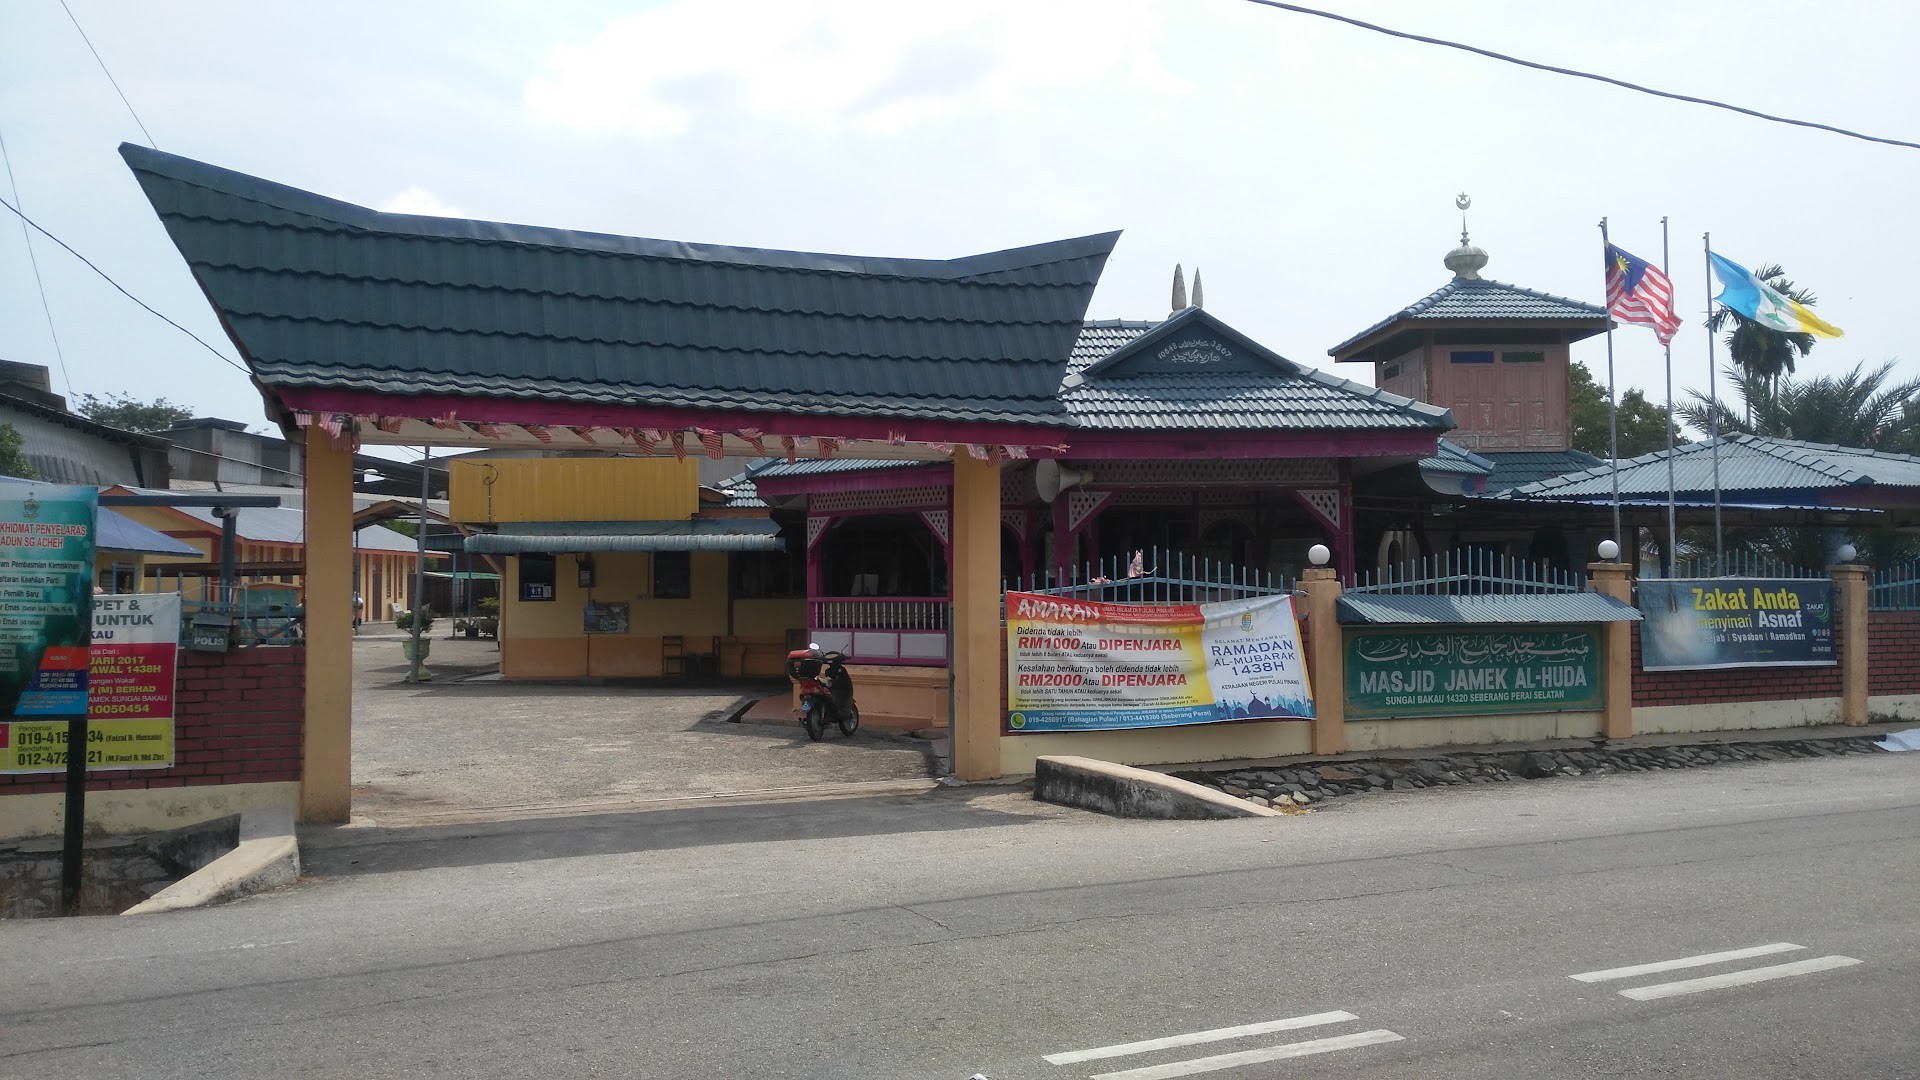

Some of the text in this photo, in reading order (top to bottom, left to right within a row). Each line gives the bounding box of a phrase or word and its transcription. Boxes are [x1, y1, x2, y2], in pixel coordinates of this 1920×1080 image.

[36, 524, 86, 535] PENYELARAS
[0, 536, 63, 547] ADUN SG ACHEH
[1692, 587, 1748, 611] Zakat
[1753, 587, 1800, 610] Anda
[129, 600, 140, 610] &
[1017, 599, 1100, 621] AMARAN
[96, 614, 153, 625] UNTUK
[1697, 610, 1803, 632] menyinari Asnaf
[1017, 627, 1082, 637] Didenda tidak lebih
[1732, 633, 1764, 643] Syaaban
[1770, 632, 1806, 641] Ramadhan
[193, 637, 224, 646] POLIS
[1018, 637, 1182, 651] RM1000 Atau DIPENJARA
[1211, 640, 1294, 656] RAMADAN
[118, 656, 144, 664] 2017
[1214, 652, 1296, 667] AL-MUBARAK
[127, 665, 161, 673] 1438H
[1018, 664, 1179, 674] Kesalahan berikutnya boleh didenda tidak lebih
[1232, 661, 1285, 676] 1438H
[1019, 674, 1187, 686] RM2000 Atau DIPENJARA
[1360, 666, 1587, 694] MASJID JAMEK AL-HUDA
[98, 686, 112, 694] (M)
[1221, 682, 1248, 690] KERAJAAN
[1386, 690, 1565, 705] SUNGAI BAKAU 14320 SEBERANG PERAI SELATAN
[1068, 716, 1098, 724] (Bahagian
[1099, 715, 1118, 723] Pulau)
[1161, 711, 1192, 719] (Seberang
